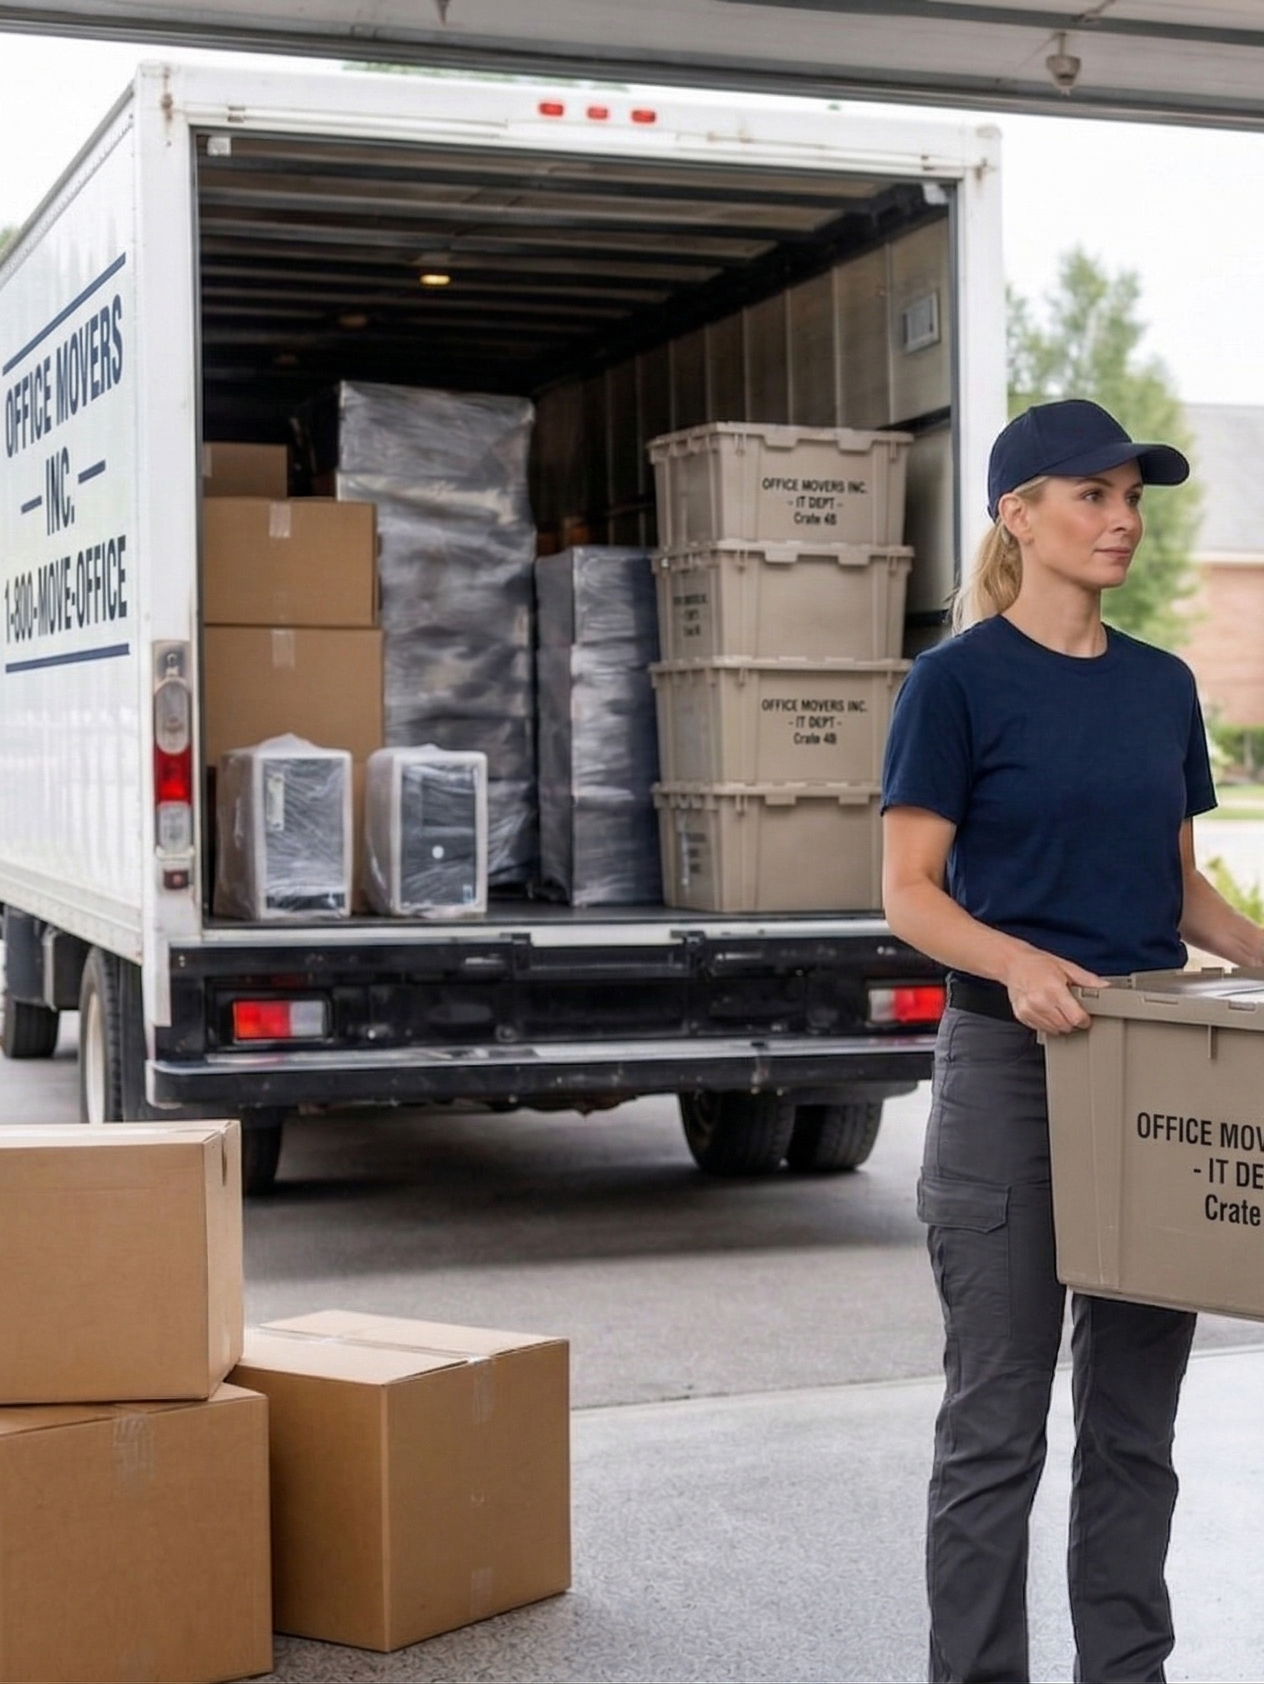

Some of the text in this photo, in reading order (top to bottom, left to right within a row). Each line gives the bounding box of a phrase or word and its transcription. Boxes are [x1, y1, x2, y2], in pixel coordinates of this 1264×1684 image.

[5, 294, 123, 459] OFFICE MOVERS
[46, 446, 75, 536] INC.
[762, 477, 798, 491] OFFICE
[802, 479, 844, 493] MOVERS
[796, 495, 806, 508] IT
[808, 496, 835, 509] DEPT
[793, 511, 820, 525] Crate
[5, 534, 127, 644] 1-800-MOVE-OFFICE
[761, 698, 798, 712] OFFICE
[801, 699, 844, 712] MOVERS
[795, 715, 806, 728] IT
[808, 715, 835, 729] DEPT
[793, 731, 820, 745] Crate
[1137, 1112, 1212, 1146] OFFICE
[1209, 1157, 1229, 1184] IT
[1205, 1194, 1261, 1226] Crate
